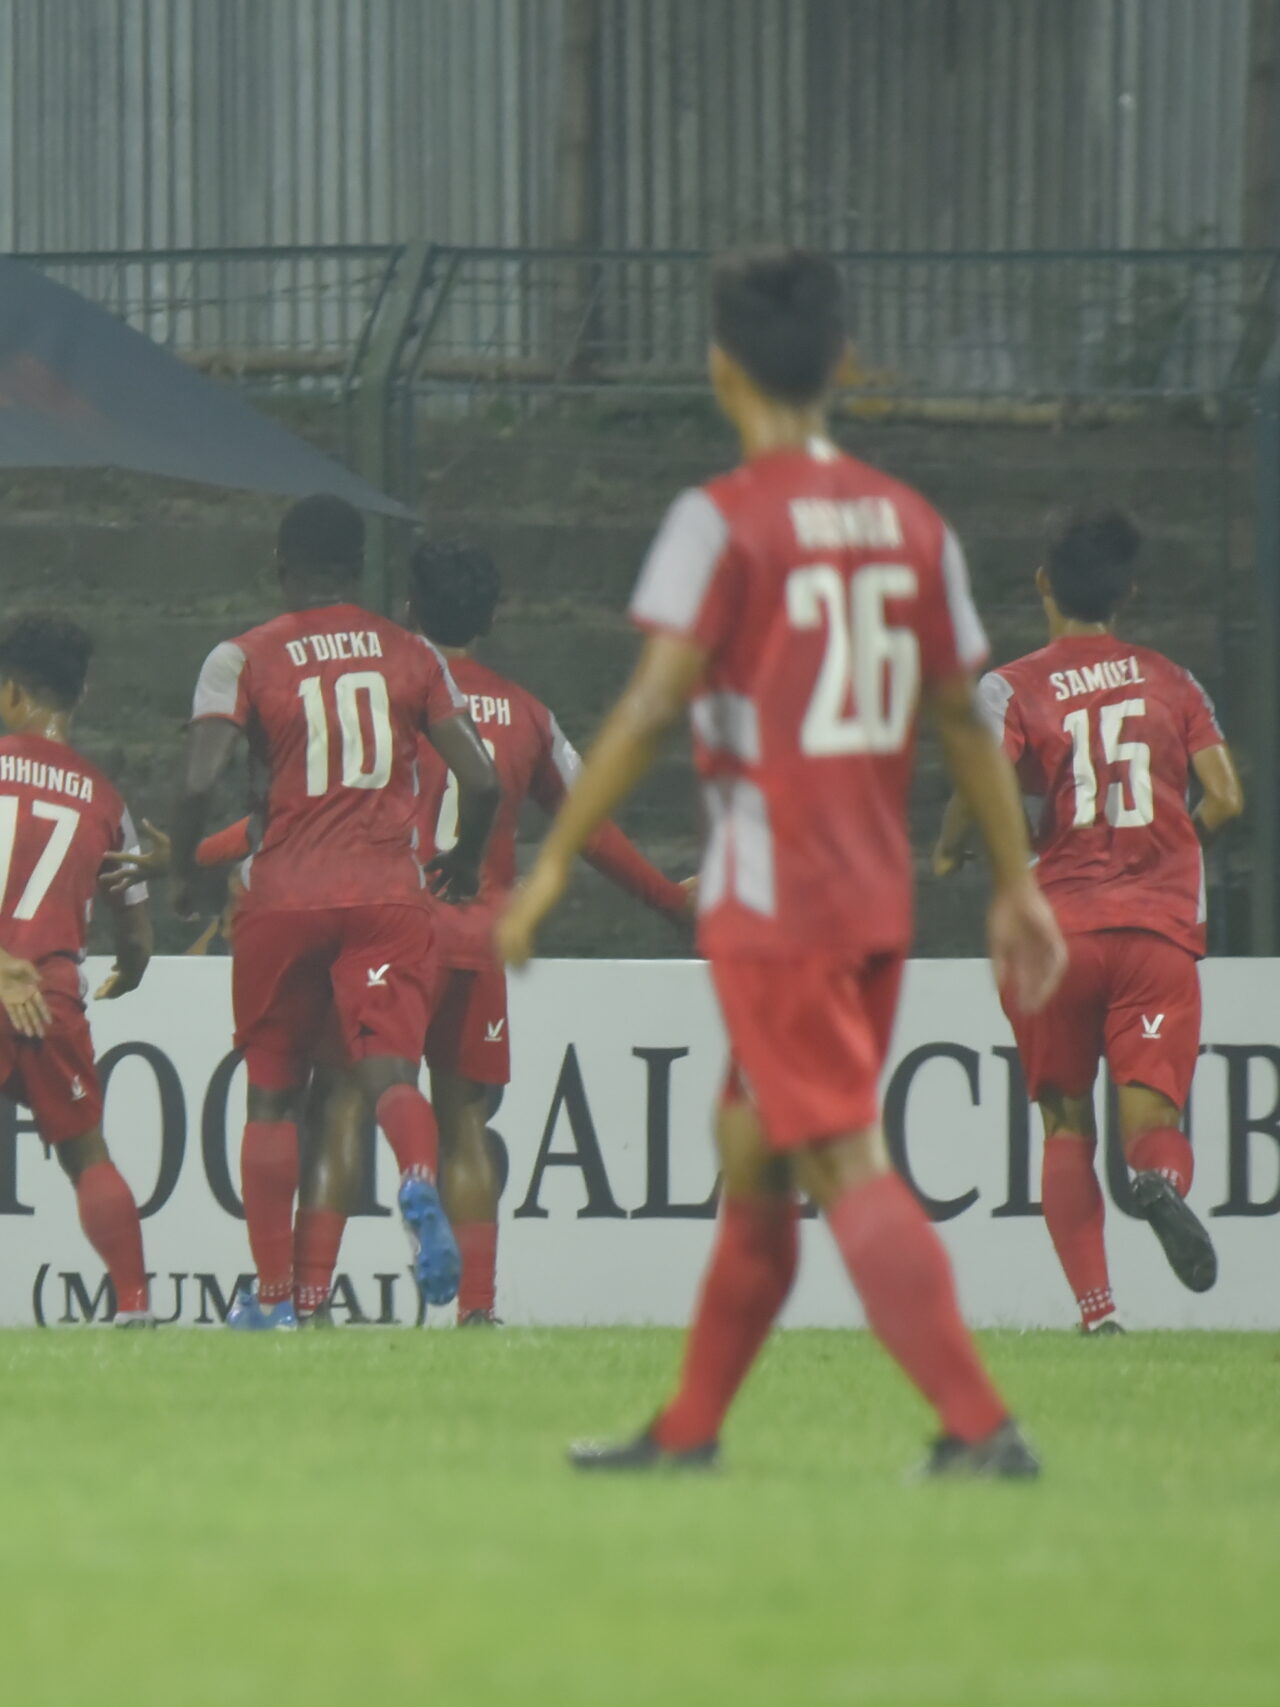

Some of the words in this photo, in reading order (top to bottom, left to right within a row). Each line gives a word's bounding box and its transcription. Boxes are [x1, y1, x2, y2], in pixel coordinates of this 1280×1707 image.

[785, 562, 920, 757] 26
[1049, 655, 1146, 701] SAMUEL
[298, 671, 393, 797] 10
[1063, 698, 1154, 828] 15
[32, 1263, 426, 1328] (MUMAI)
